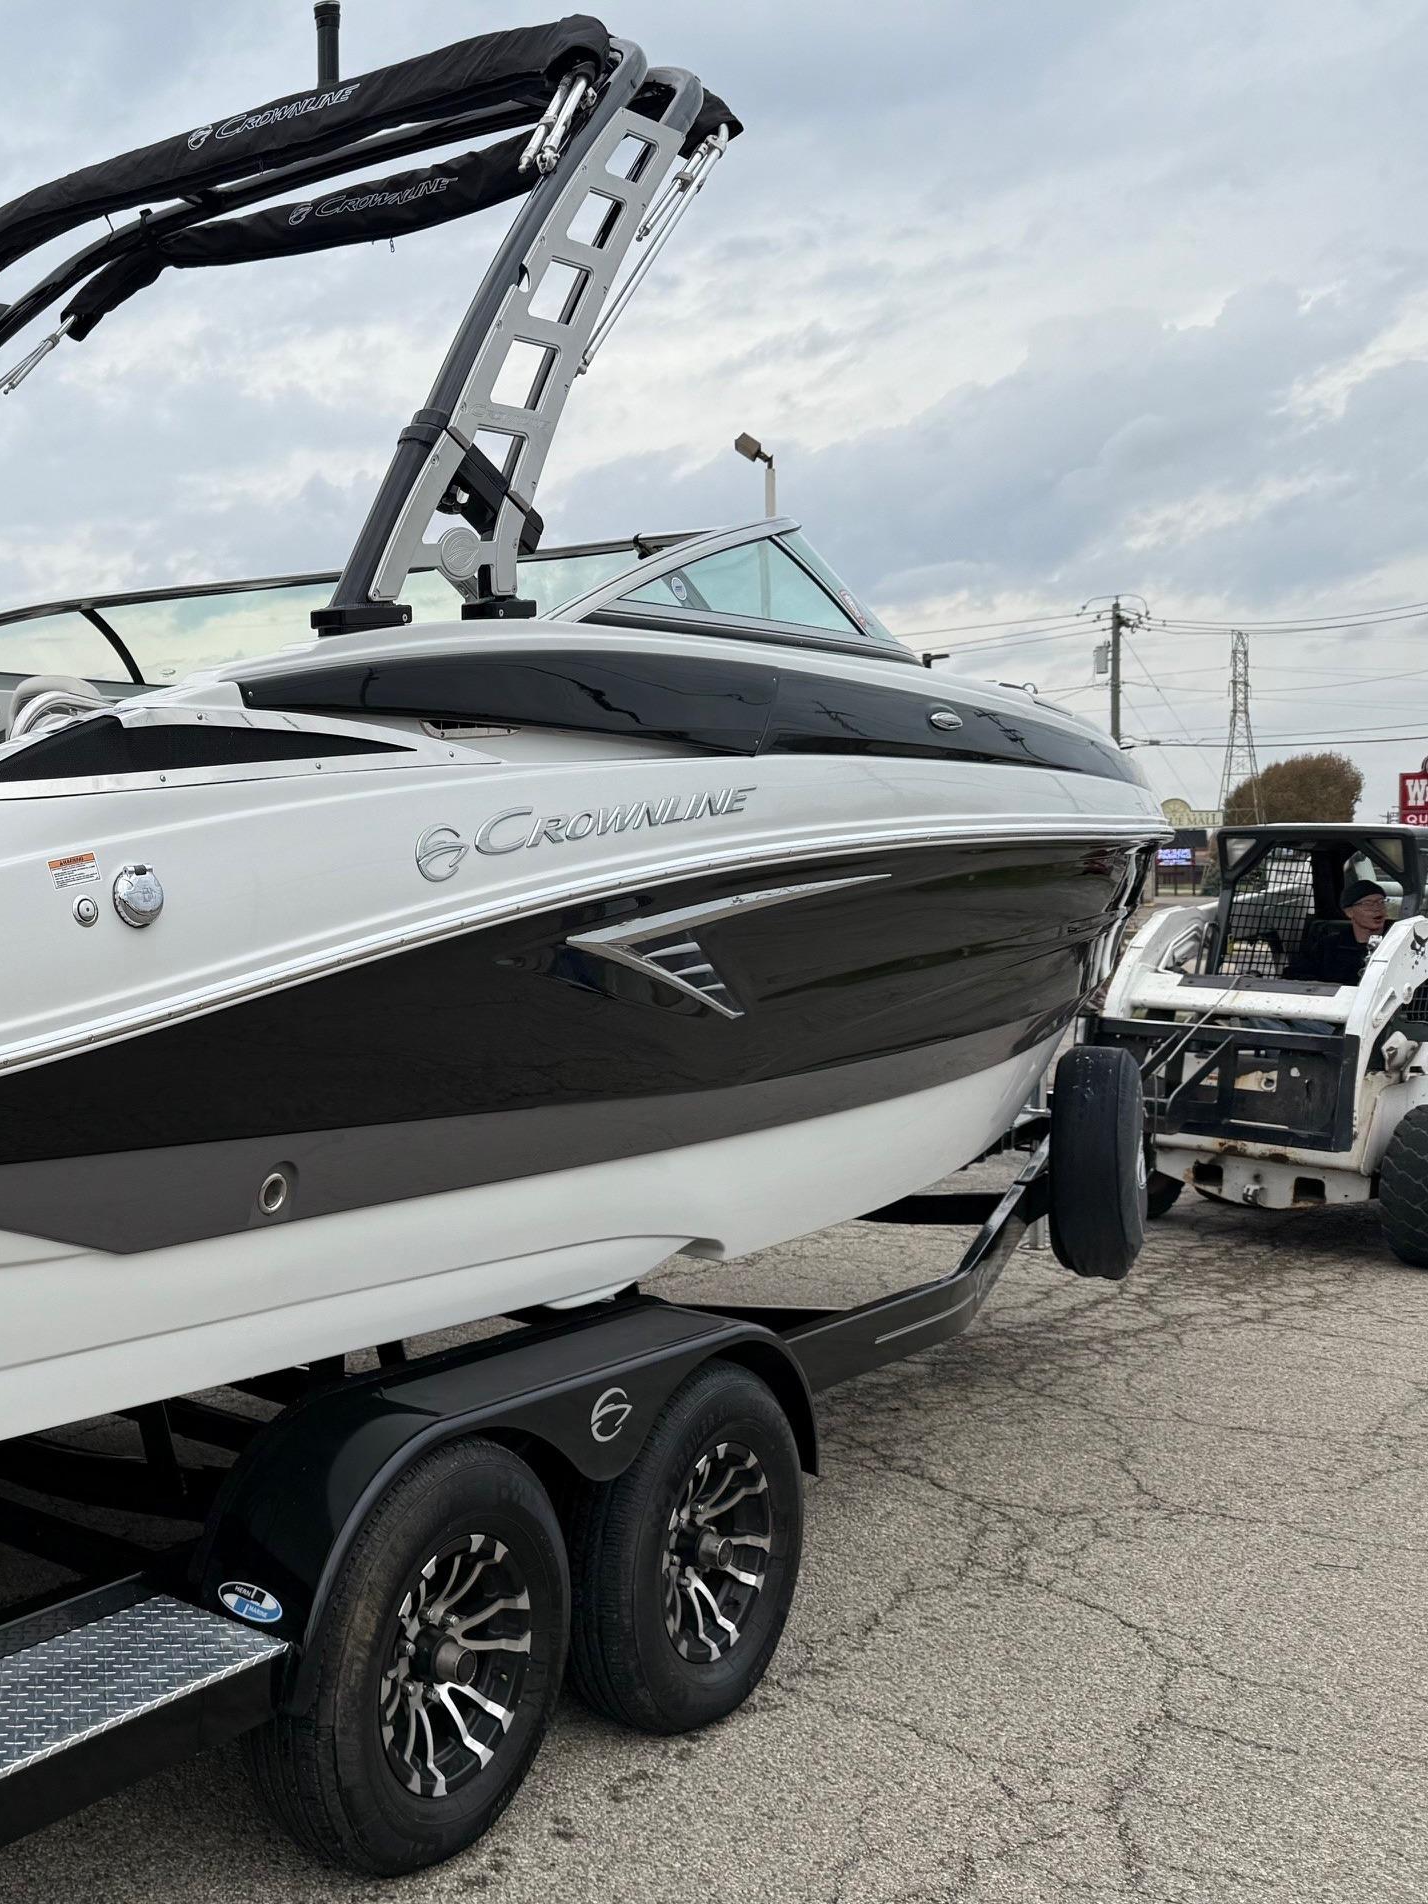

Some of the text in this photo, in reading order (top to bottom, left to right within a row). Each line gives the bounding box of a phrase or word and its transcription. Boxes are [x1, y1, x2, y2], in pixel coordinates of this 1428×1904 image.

[215, 83, 361, 139] CROWNLINE
[316, 177, 459, 217] CROWNLINE
[474, 785, 758, 856] CROWNLINE
[234, 1585, 252, 1597] HERN
